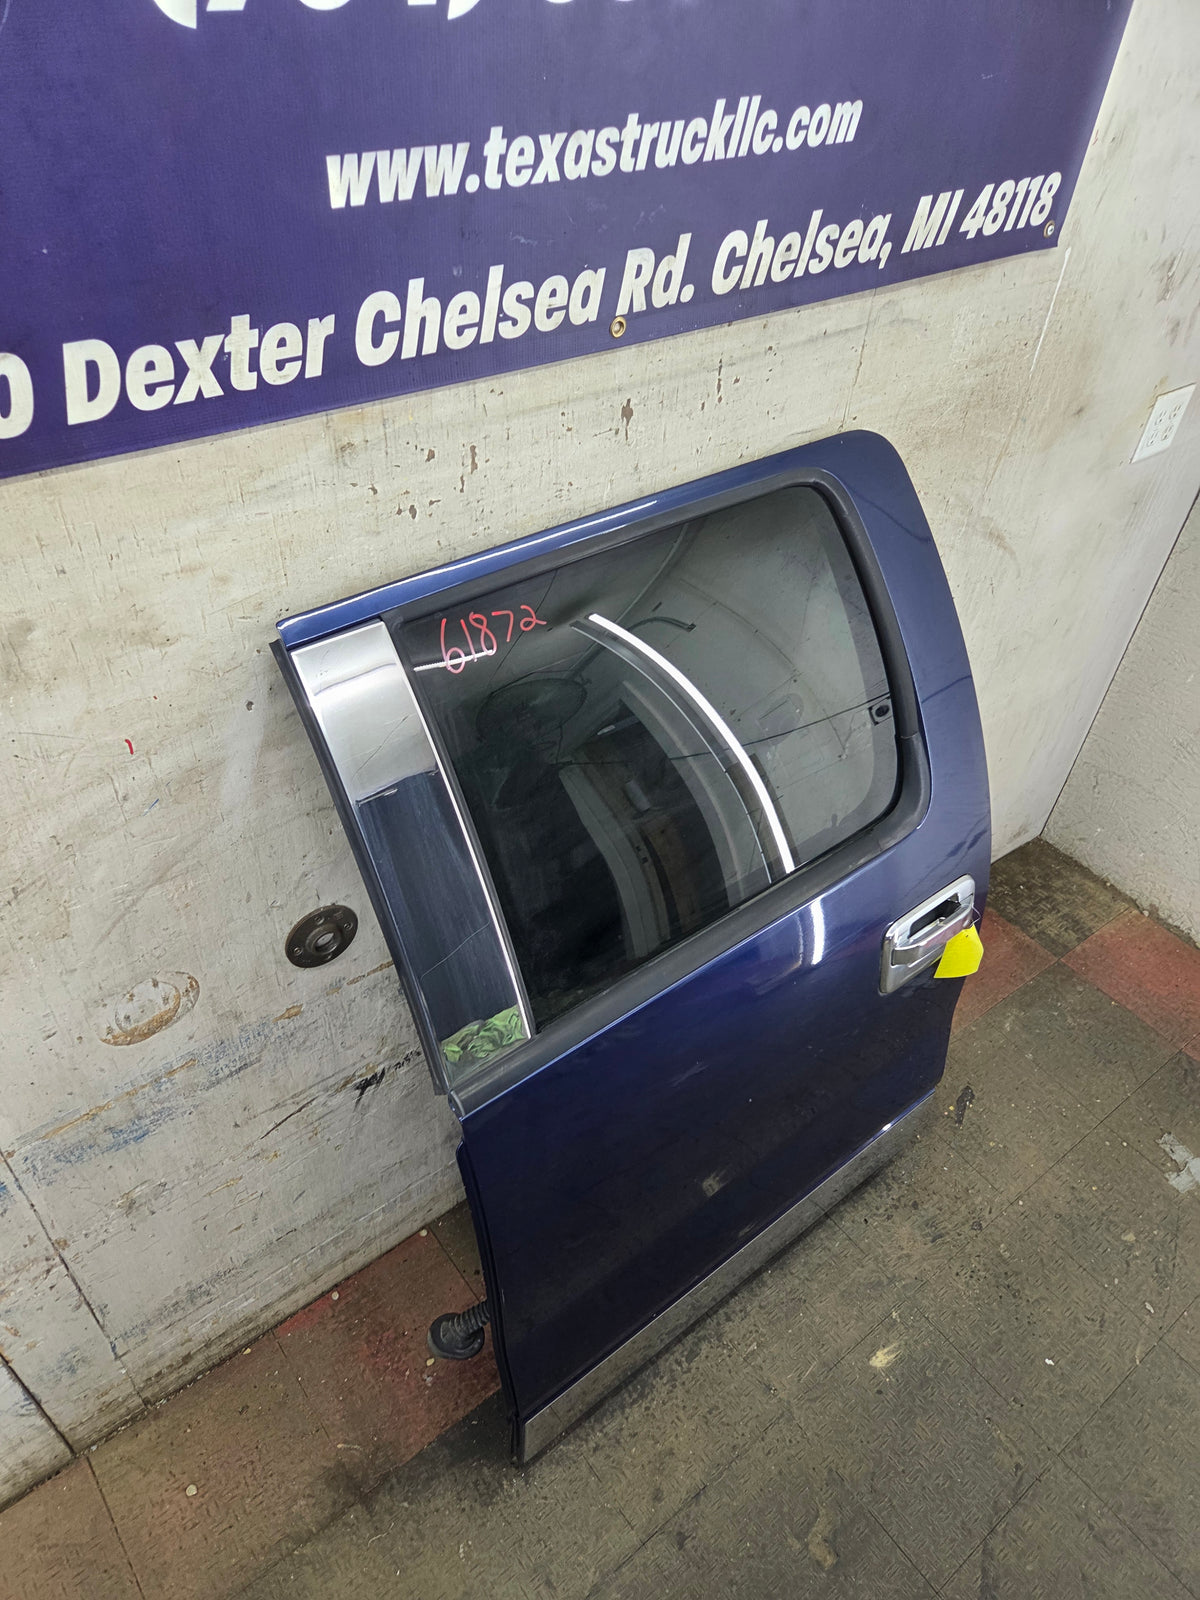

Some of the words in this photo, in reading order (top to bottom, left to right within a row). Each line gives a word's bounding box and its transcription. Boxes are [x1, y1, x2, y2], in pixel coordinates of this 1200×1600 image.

[325, 94, 864, 210] www.texastruckllc.com
[63, 314, 336, 425] Dexter
[354, 264, 607, 367] Chelsea
[616, 232, 695, 317] Rd.
[711, 208, 893, 296] Chelsea,
[900, 188, 965, 255] MI
[958, 171, 1062, 240] 48118
[440, 605, 547, 674] 61872
